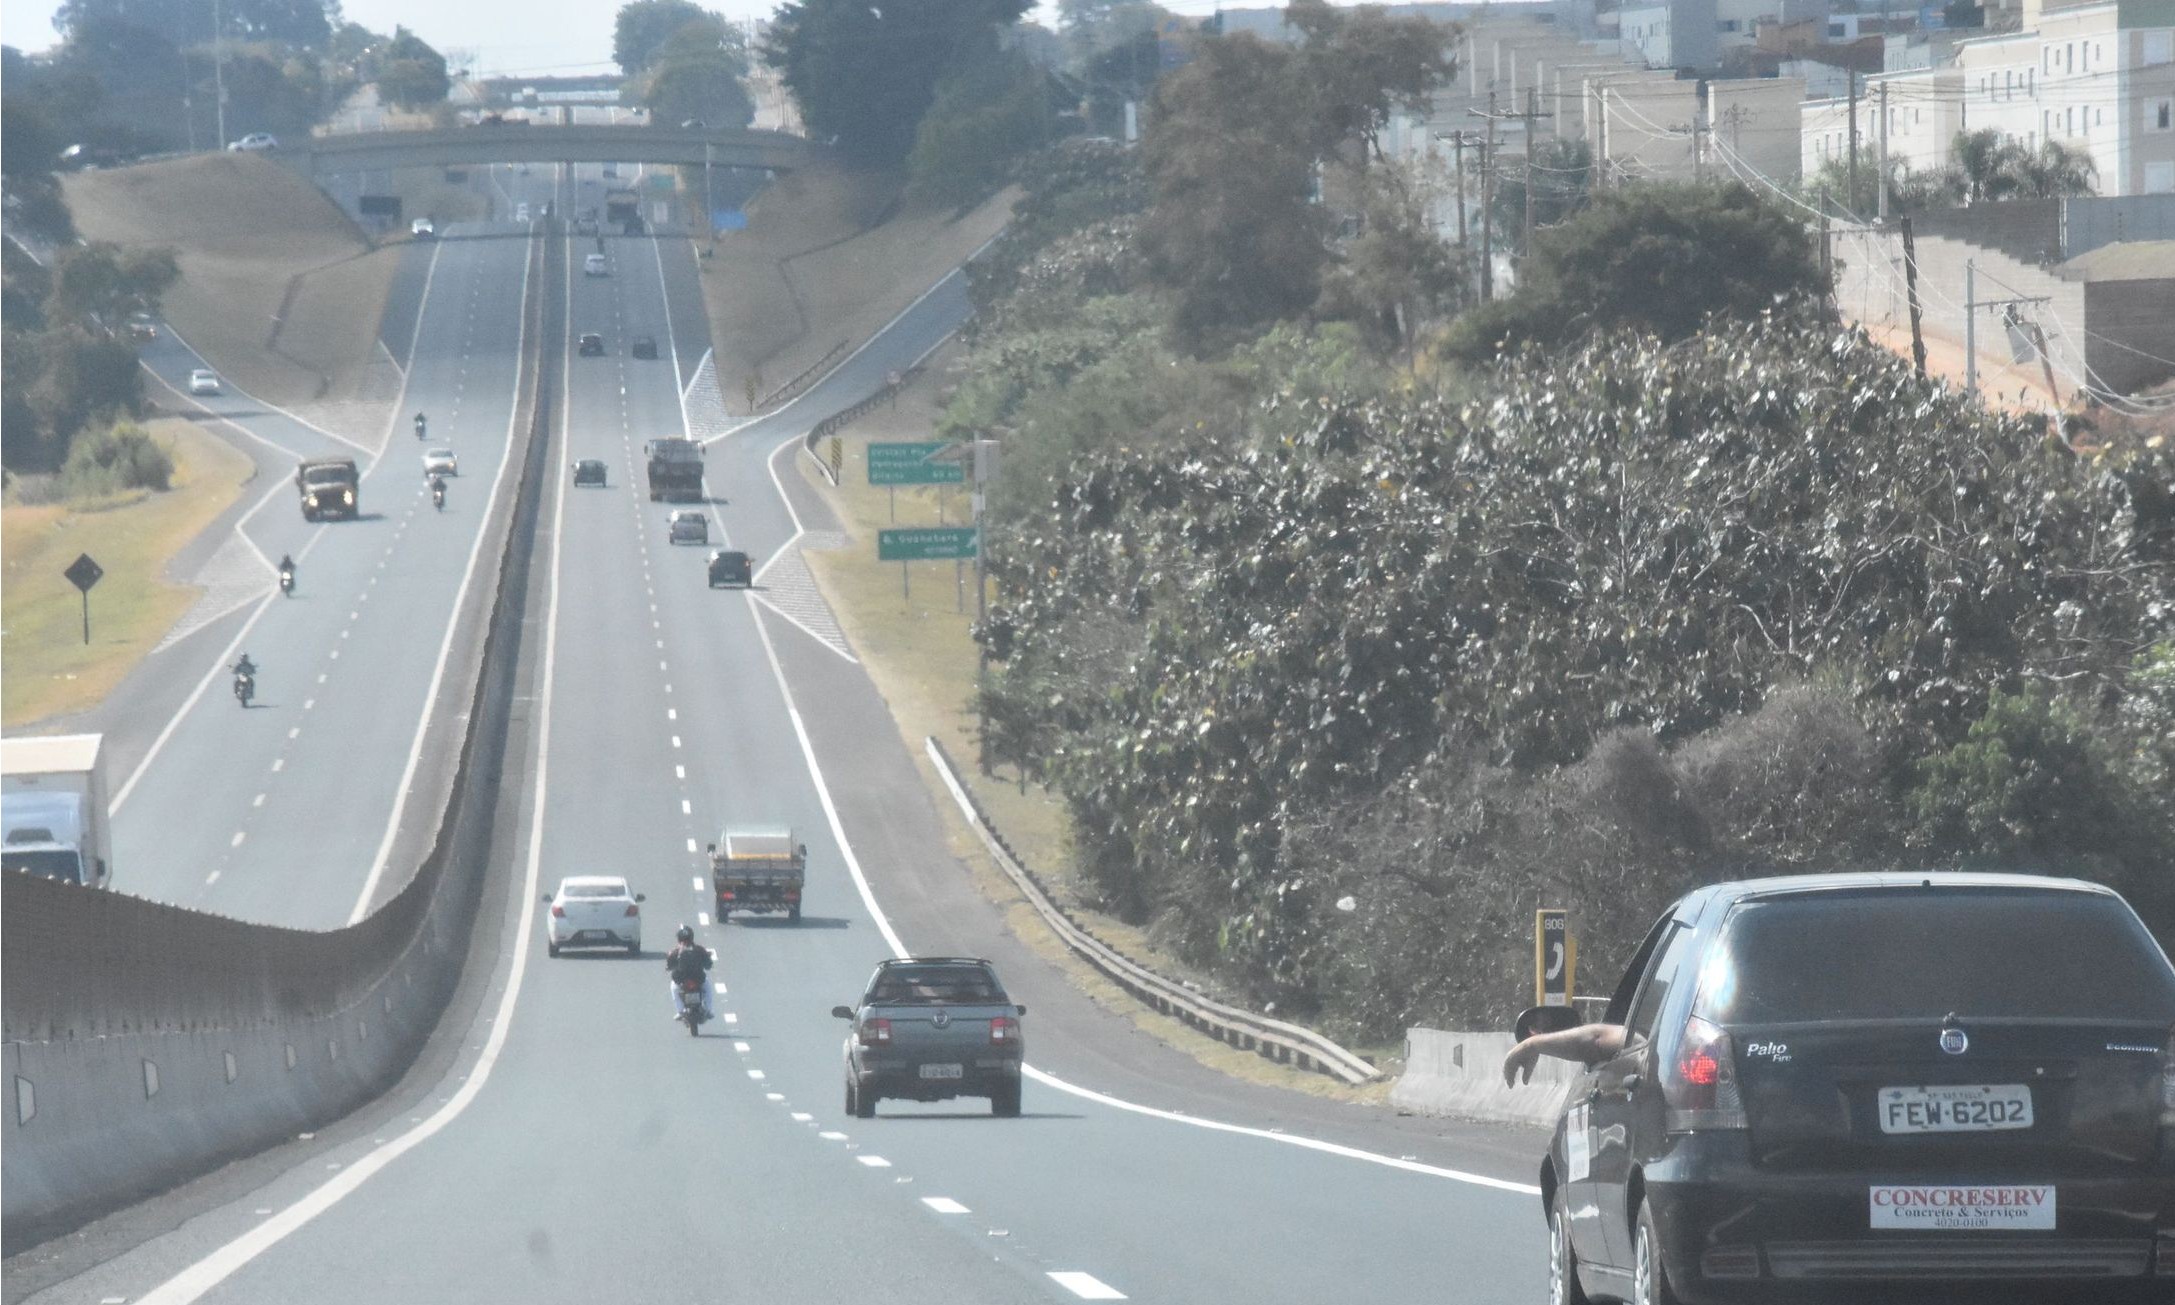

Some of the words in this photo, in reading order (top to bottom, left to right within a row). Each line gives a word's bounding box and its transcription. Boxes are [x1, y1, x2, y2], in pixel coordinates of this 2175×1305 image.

[1747, 1041, 1787, 1056] Palio
[1873, 1188, 2047, 1206] CONCRESERV
[1894, 1207, 1954, 1218] Concreto
[1957, 1207, 1970, 1217] &
[1974, 1207, 2029, 1220] Serviços
